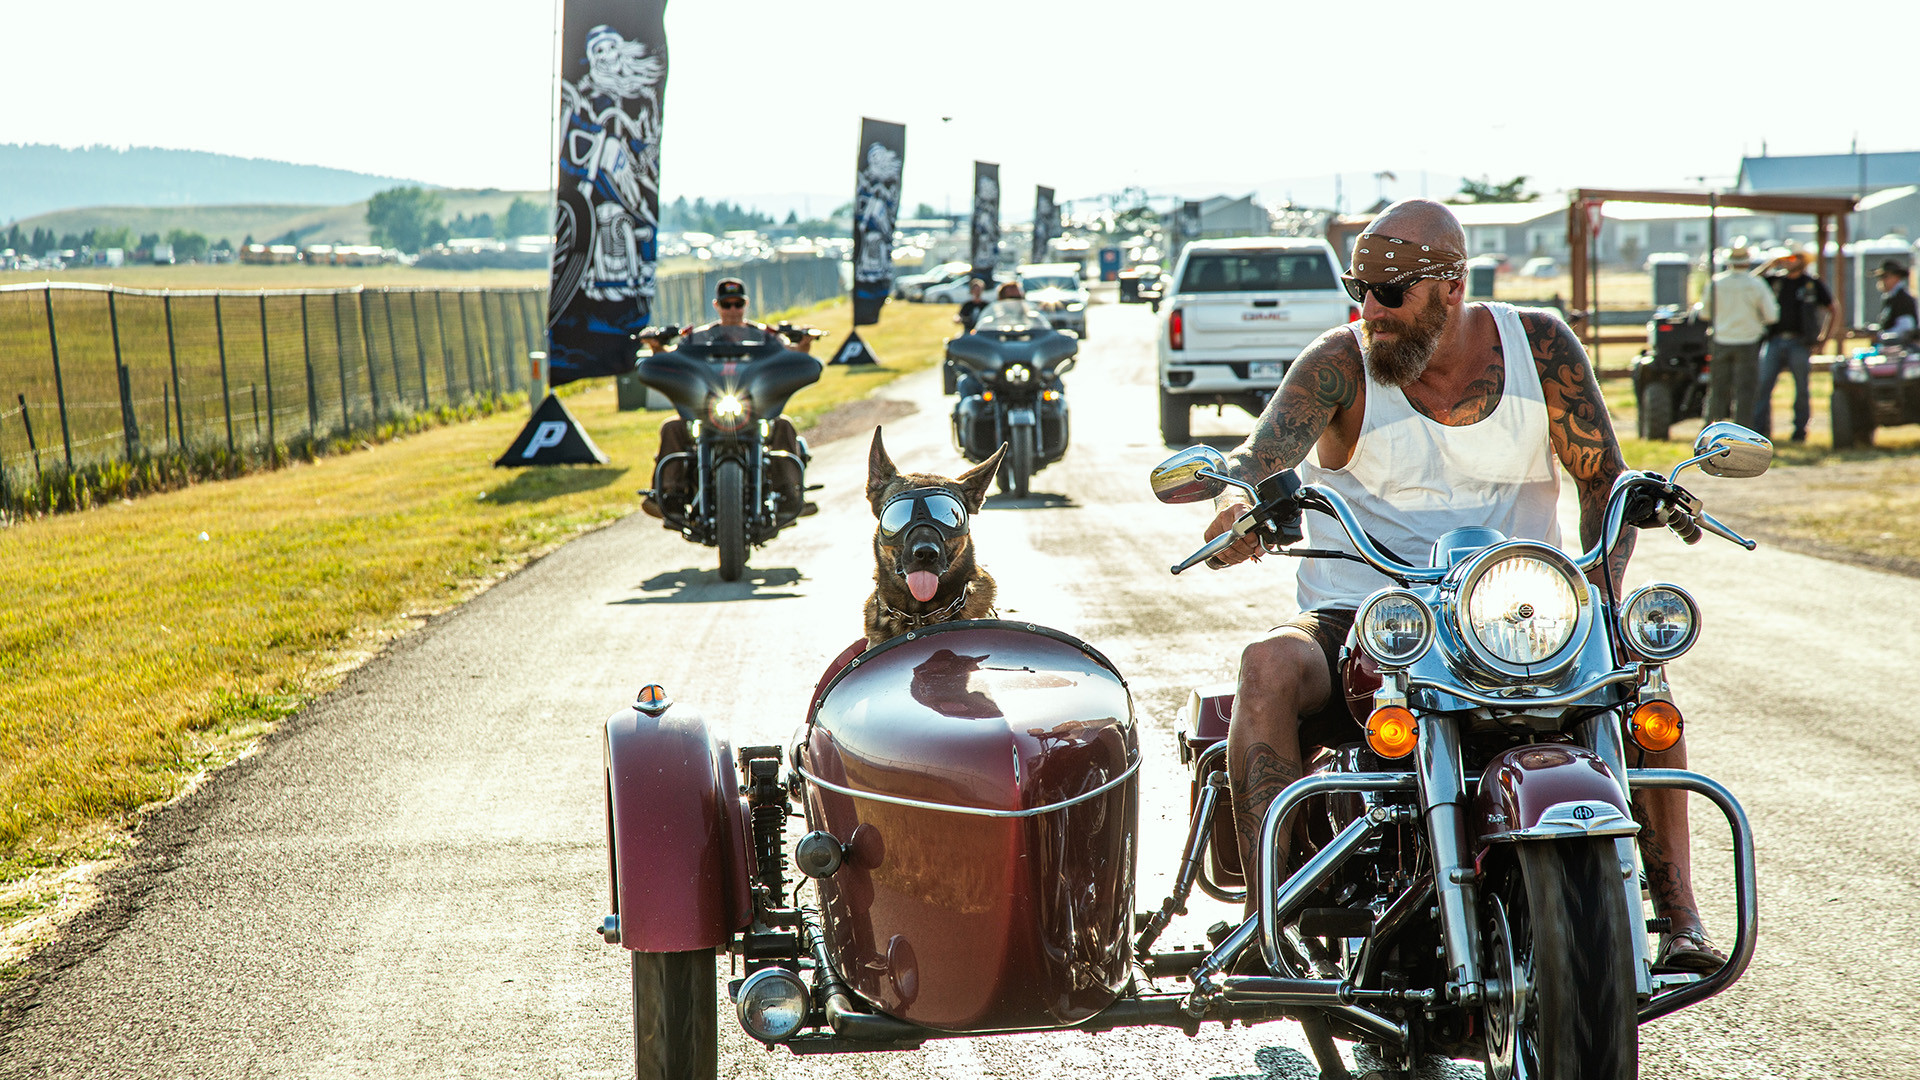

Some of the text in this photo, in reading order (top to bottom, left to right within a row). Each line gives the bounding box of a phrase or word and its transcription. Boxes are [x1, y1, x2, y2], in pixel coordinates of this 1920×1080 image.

[1242, 310, 1290, 321] GMC
[839, 341, 864, 363] P
[521, 421, 568, 459] P
